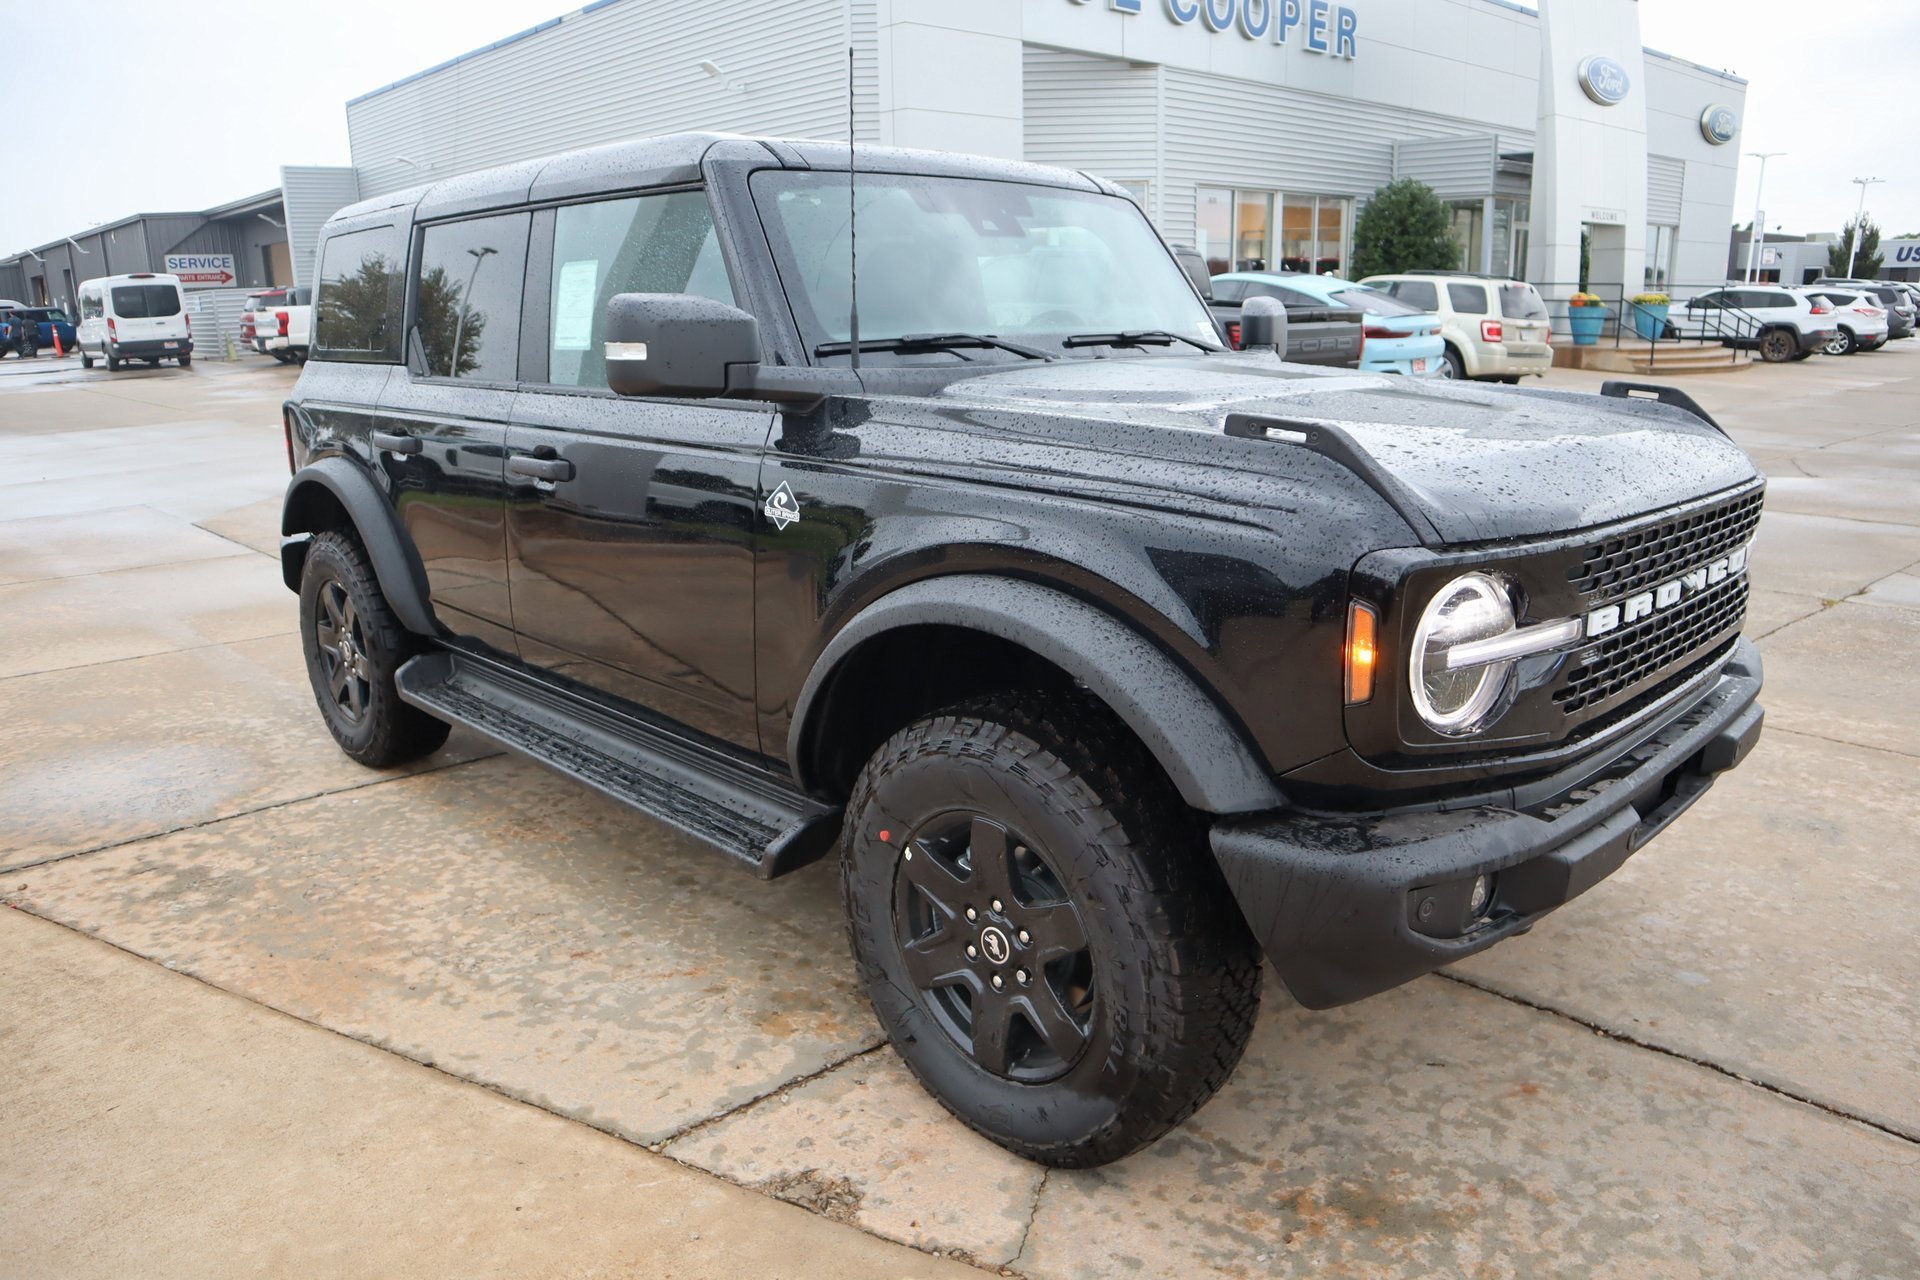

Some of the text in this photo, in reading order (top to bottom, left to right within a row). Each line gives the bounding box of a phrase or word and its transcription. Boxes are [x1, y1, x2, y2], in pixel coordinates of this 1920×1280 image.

[1163, 0, 1357, 59] COOPER
[1591, 210, 1617, 221] WELCOME
[168, 257, 231, 269] SERVICE
[1586, 546, 1747, 637] BRONCO
